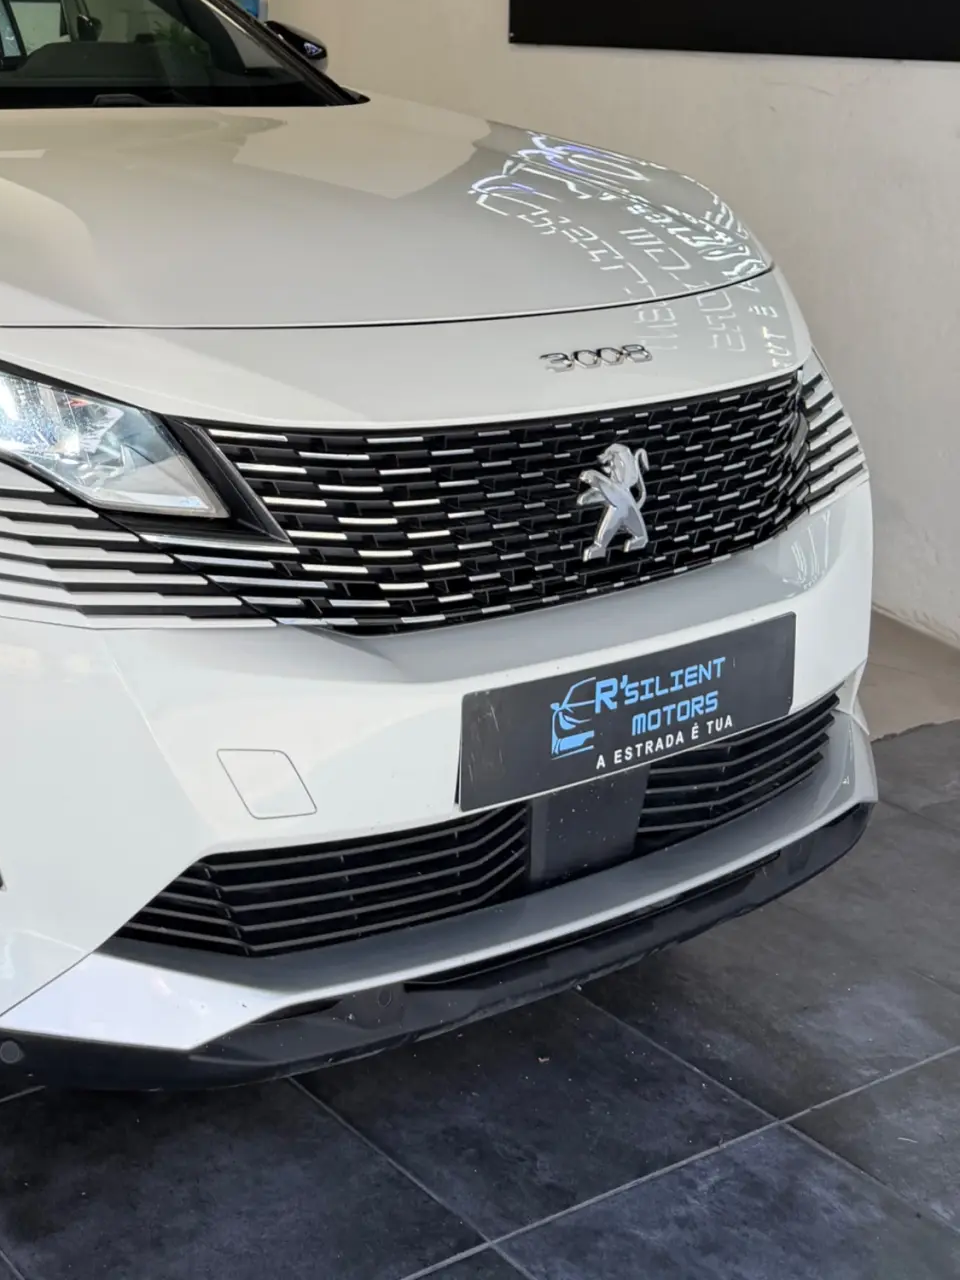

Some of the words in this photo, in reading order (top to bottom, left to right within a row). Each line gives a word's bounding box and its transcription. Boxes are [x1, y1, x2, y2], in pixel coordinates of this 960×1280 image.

[539, 344, 653, 372] 3008
[594, 656, 726, 714] R'SILIENT
[631, 690, 719, 736] MOTORS
[596, 754, 606, 770] A
[613, 730, 685, 765] ESTRADA
[691, 722, 699, 740] É
[706, 714, 733, 735] TUA
